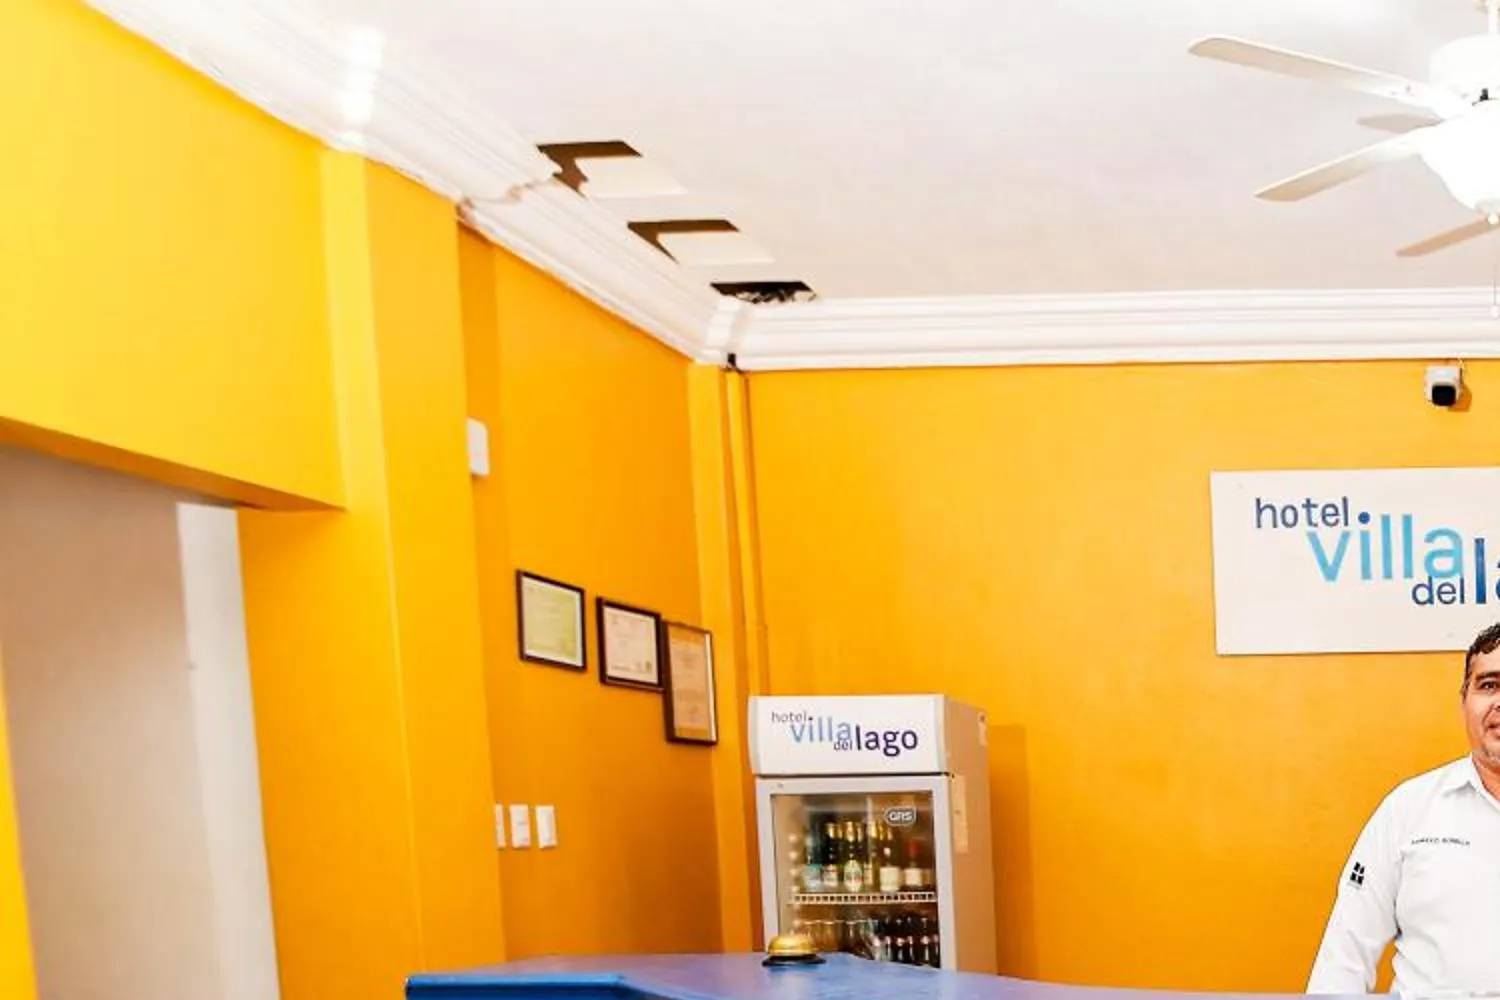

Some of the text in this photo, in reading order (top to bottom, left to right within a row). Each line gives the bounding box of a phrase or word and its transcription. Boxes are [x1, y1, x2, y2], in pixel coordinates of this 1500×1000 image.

[1255, 497, 1350, 529] hotel
[1306, 511, 1463, 582] villa
[1411, 575, 1466, 605] del
[771, 711, 807, 723] hotel
[790, 716, 851, 743] villa
[833, 724, 919, 757] del lago
